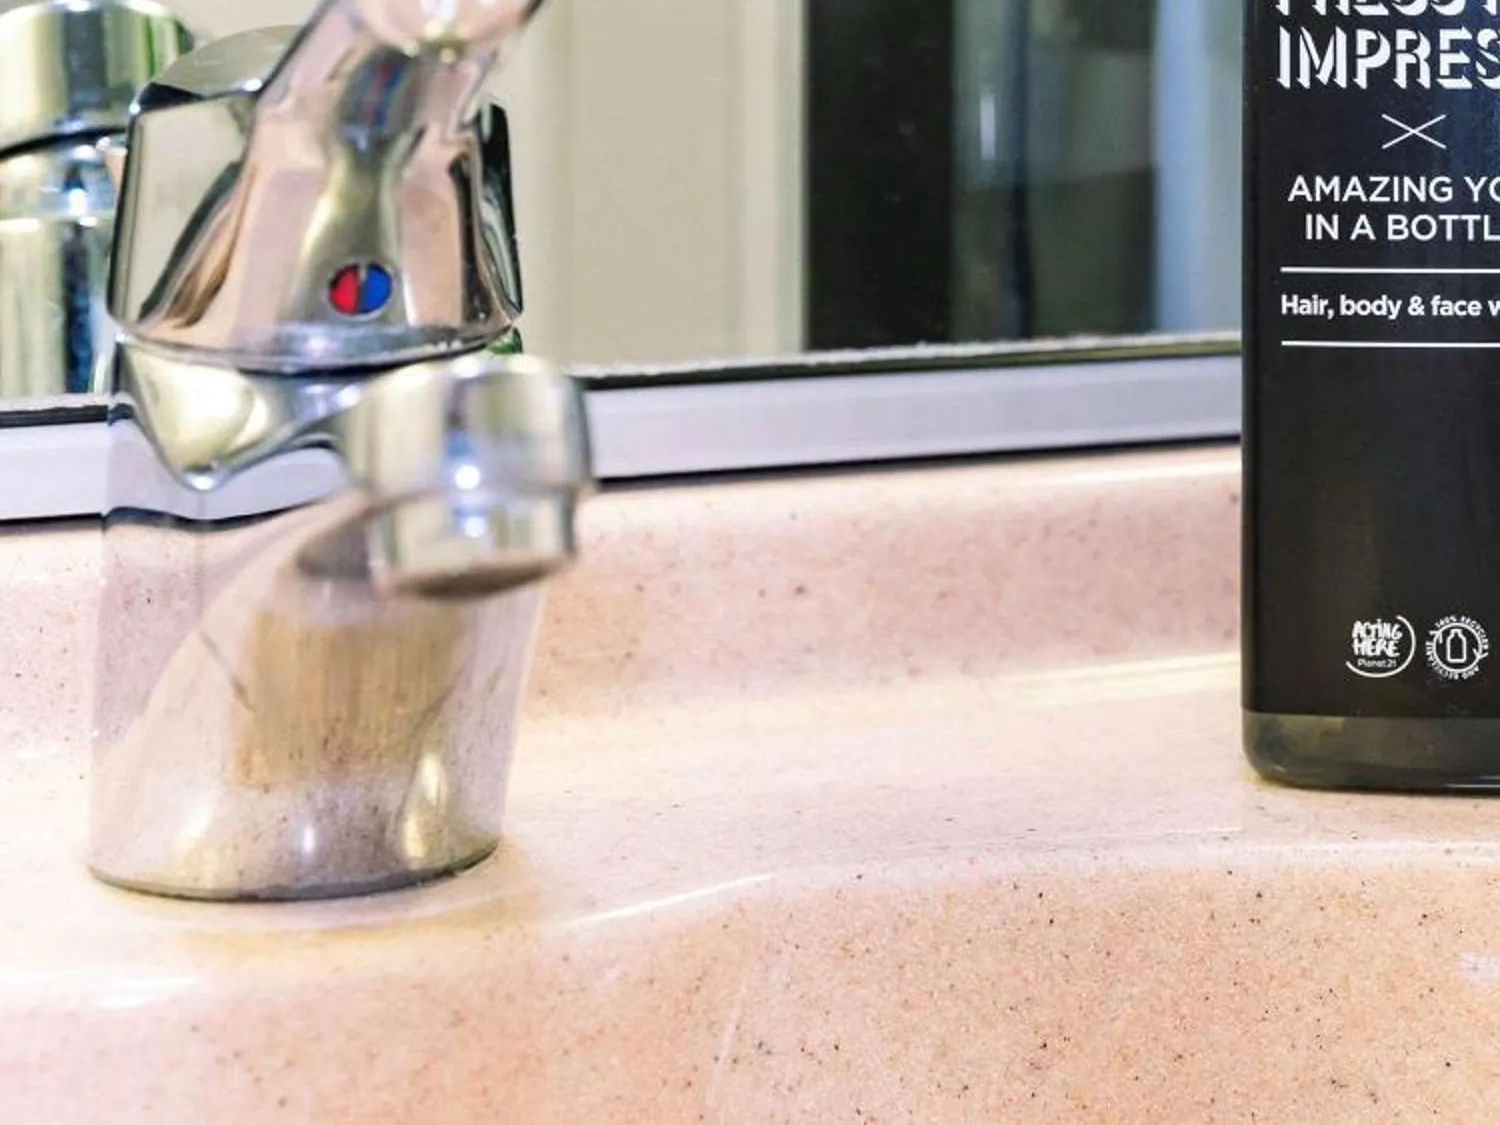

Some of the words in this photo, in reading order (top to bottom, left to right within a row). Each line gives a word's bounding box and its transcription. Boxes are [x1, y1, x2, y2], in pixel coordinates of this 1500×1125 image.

[1288, 176, 1452, 202] AMAZING
[1307, 214, 1338, 239] IN
[1351, 215, 1375, 240] A
[1282, 295, 1333, 319] Hair,
[1340, 295, 1402, 319] body
[1408, 296, 1424, 315] &
[1431, 295, 1482, 316] face
[1352, 638, 1400, 657] HERE
